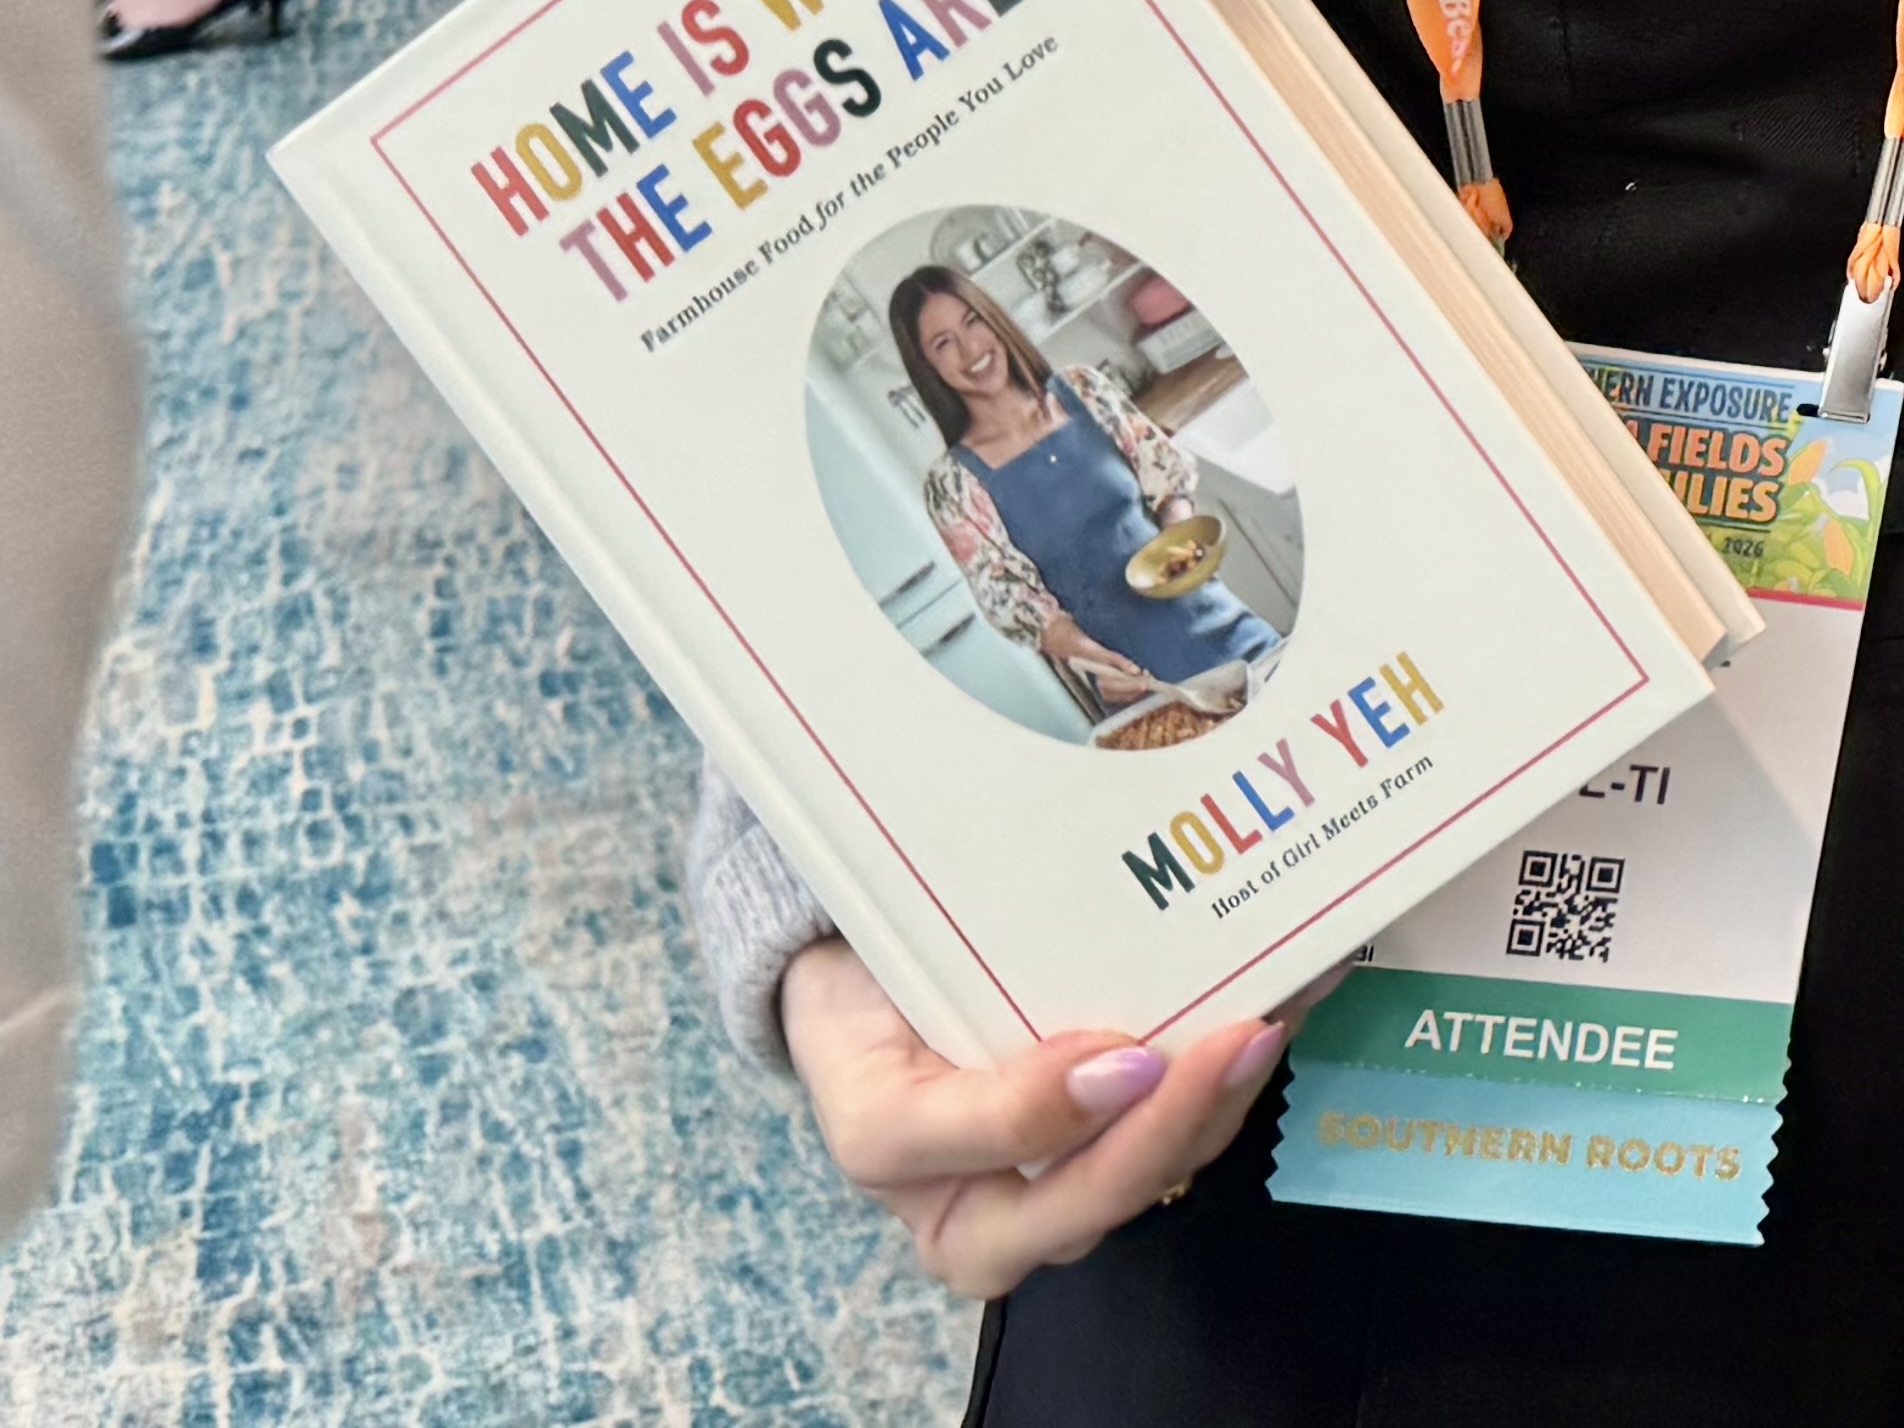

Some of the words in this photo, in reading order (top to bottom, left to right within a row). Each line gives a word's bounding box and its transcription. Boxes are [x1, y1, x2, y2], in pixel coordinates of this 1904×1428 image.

[471, 50, 676, 236] HOME
[558, 164, 712, 302] THE
[691, 38, 882, 210] EGGS
[640, 256, 759, 352] Farmhouse
[758, 214, 814, 266] Food
[810, 191, 847, 239] for
[848, 162, 887, 198] the
[885, 107, 959, 171] People
[959, 76, 1004, 115] You
[1004, 34, 1059, 80] Love
[1585, 367, 1654, 409] HERN
[1659, 375, 1791, 424] EXPOSURE
[1650, 426, 1787, 477] FIELDS
[1661, 468, 1780, 523] ILIES
[1722, 536, 1764, 558] 2026
[1121, 738, 1316, 911] MOLLY
[1311, 651, 1445, 769] YEH
[1211, 880, 1259, 920] Host
[1261, 856, 1281, 888] of
[1281, 827, 1322, 871] Girl
[1321, 790, 1380, 843] Meets
[1378, 753, 1434, 802] Farm
[1405, 1009, 1678, 1070] ATTENDEE
[1317, 1109, 1572, 1164] SOUTHERN
[1585, 1133, 1741, 1181] ROOTS
